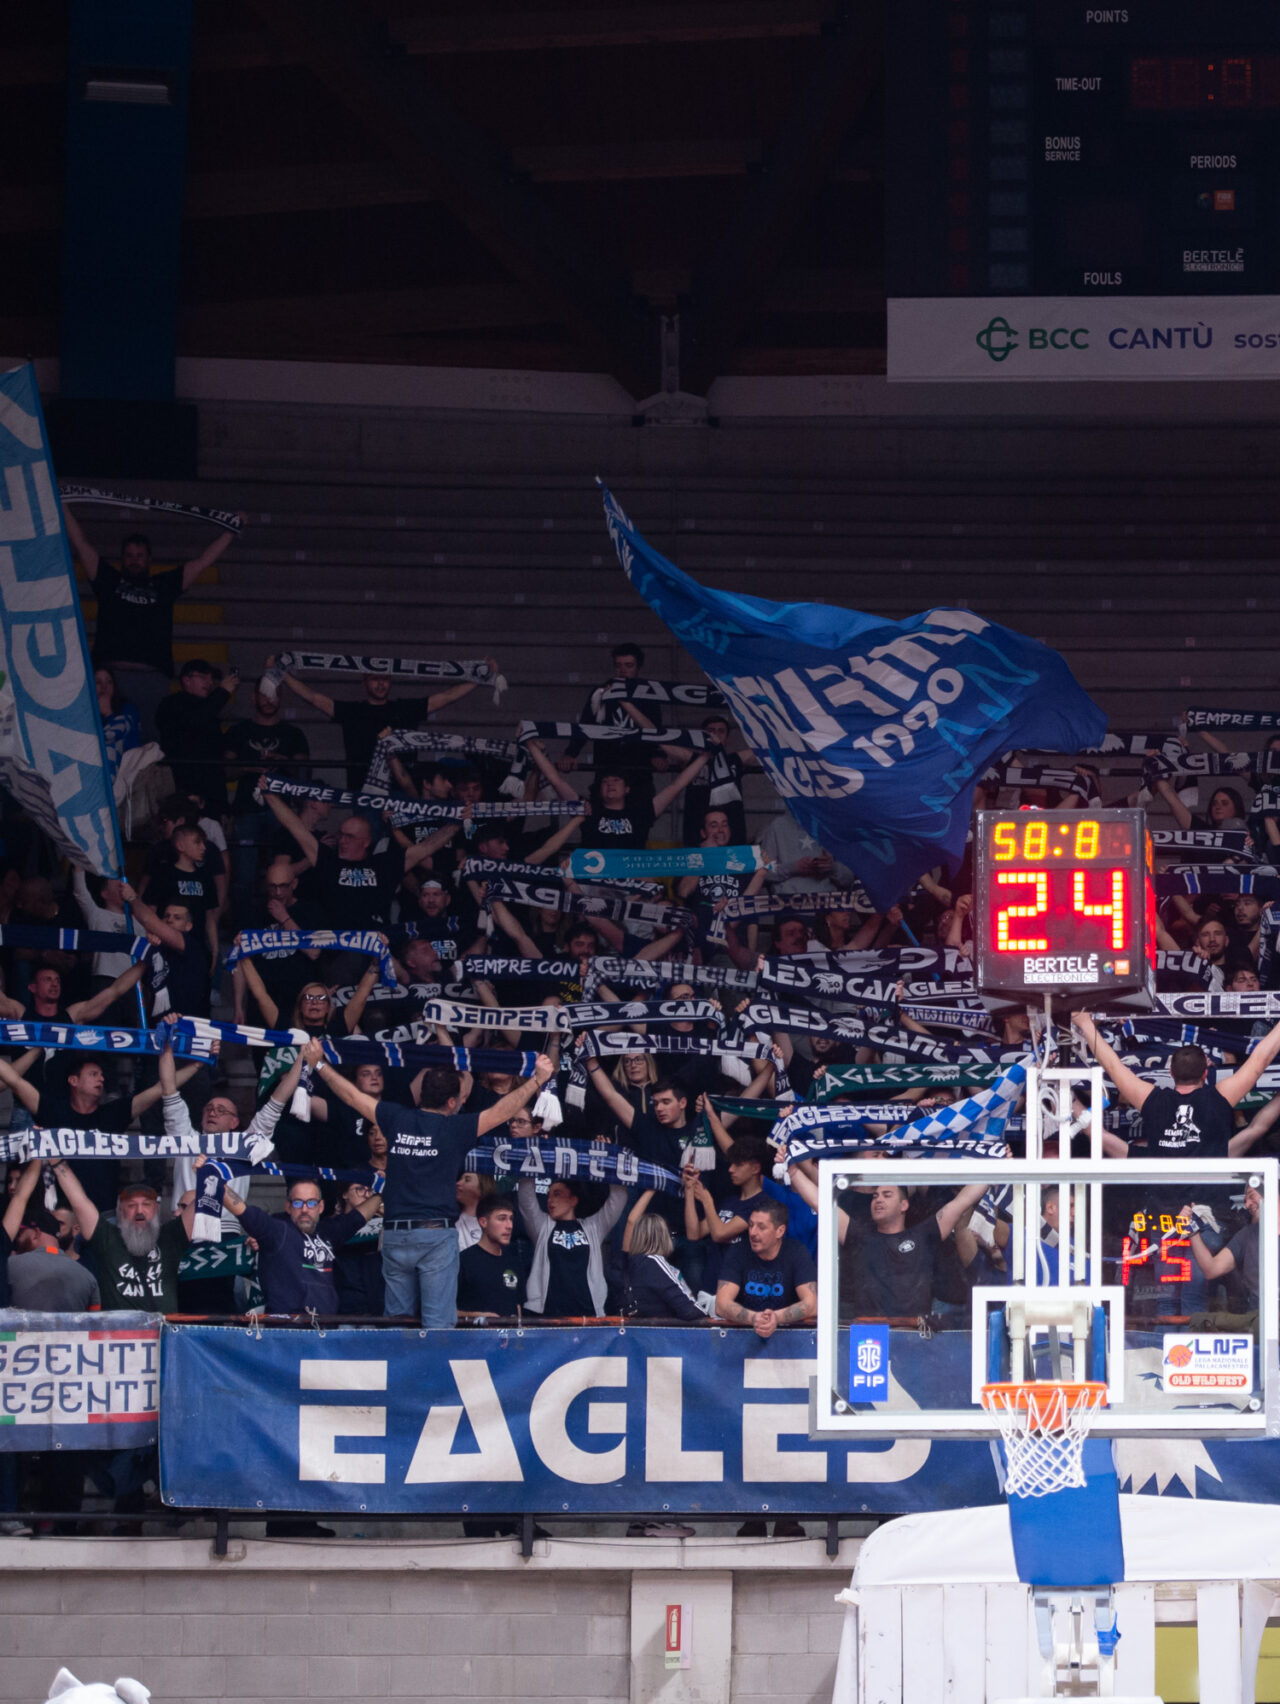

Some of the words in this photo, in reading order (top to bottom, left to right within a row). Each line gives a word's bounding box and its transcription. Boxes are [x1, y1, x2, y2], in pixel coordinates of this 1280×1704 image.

[1086, 10, 1129, 23] POINTS
[1056, 77, 1101, 91] TIME-OUT
[1045, 136, 1080, 149] BONUS
[1045, 150, 1080, 161] SERVICE
[1190, 155, 1237, 168] PERIODS
[1083, 271, 1122, 285] FOULS
[1029, 328, 1090, 350] BCC
[1108, 321, 1214, 350] CANTÙ
[302, 655, 464, 677] EAGLES
[1187, 710, 1254, 726] SEMPRE
[1260, 714, 1272, 726] E
[339, 790, 353, 804] E
[994, 820, 1100, 860] 58:8
[997, 871, 1123, 951] 24
[241, 931, 300, 950] EAGLES
[465, 958, 535, 976] SEMPRE
[450, 1006, 549, 1028] SEMPER
[394, 1133, 432, 1147] SEMPRE
[1194, 1338, 1249, 1355] LNP
[0, 1342, 157, 1376] SENTI
[853, 1374, 885, 1388] FIP
[1171, 1375, 1191, 1386] OLD
[1192, 1375, 1217, 1386] WILD
[1217, 1375, 1245, 1386] WEST
[298, 1356, 932, 1485] EAGLES
